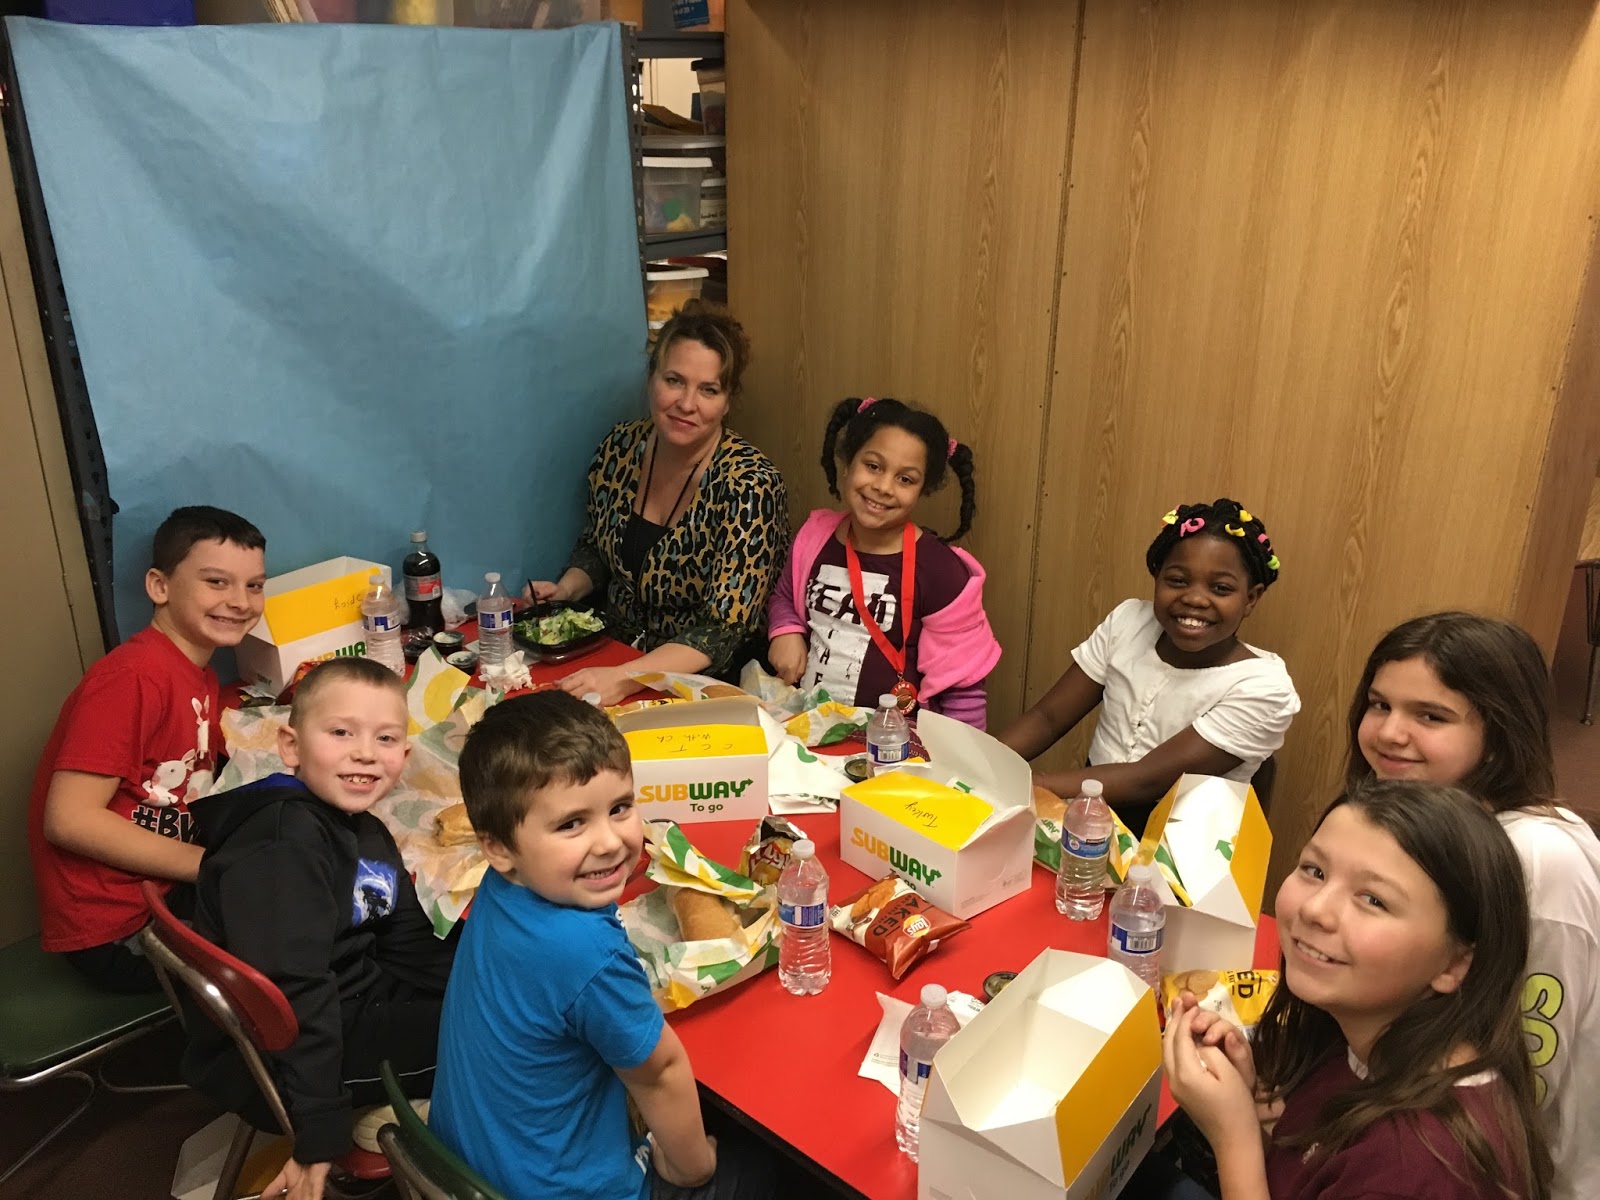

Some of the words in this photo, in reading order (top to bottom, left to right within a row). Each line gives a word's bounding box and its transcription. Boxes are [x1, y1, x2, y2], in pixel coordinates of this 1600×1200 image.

[636, 778, 754, 804] SUBWAY
[690, 803, 704, 812] To
[708, 803, 724, 813] go
[904, 801, 938, 828] Turkey
[850, 827, 942, 887] SUBWAY
[873, 898, 920, 937] AKED
